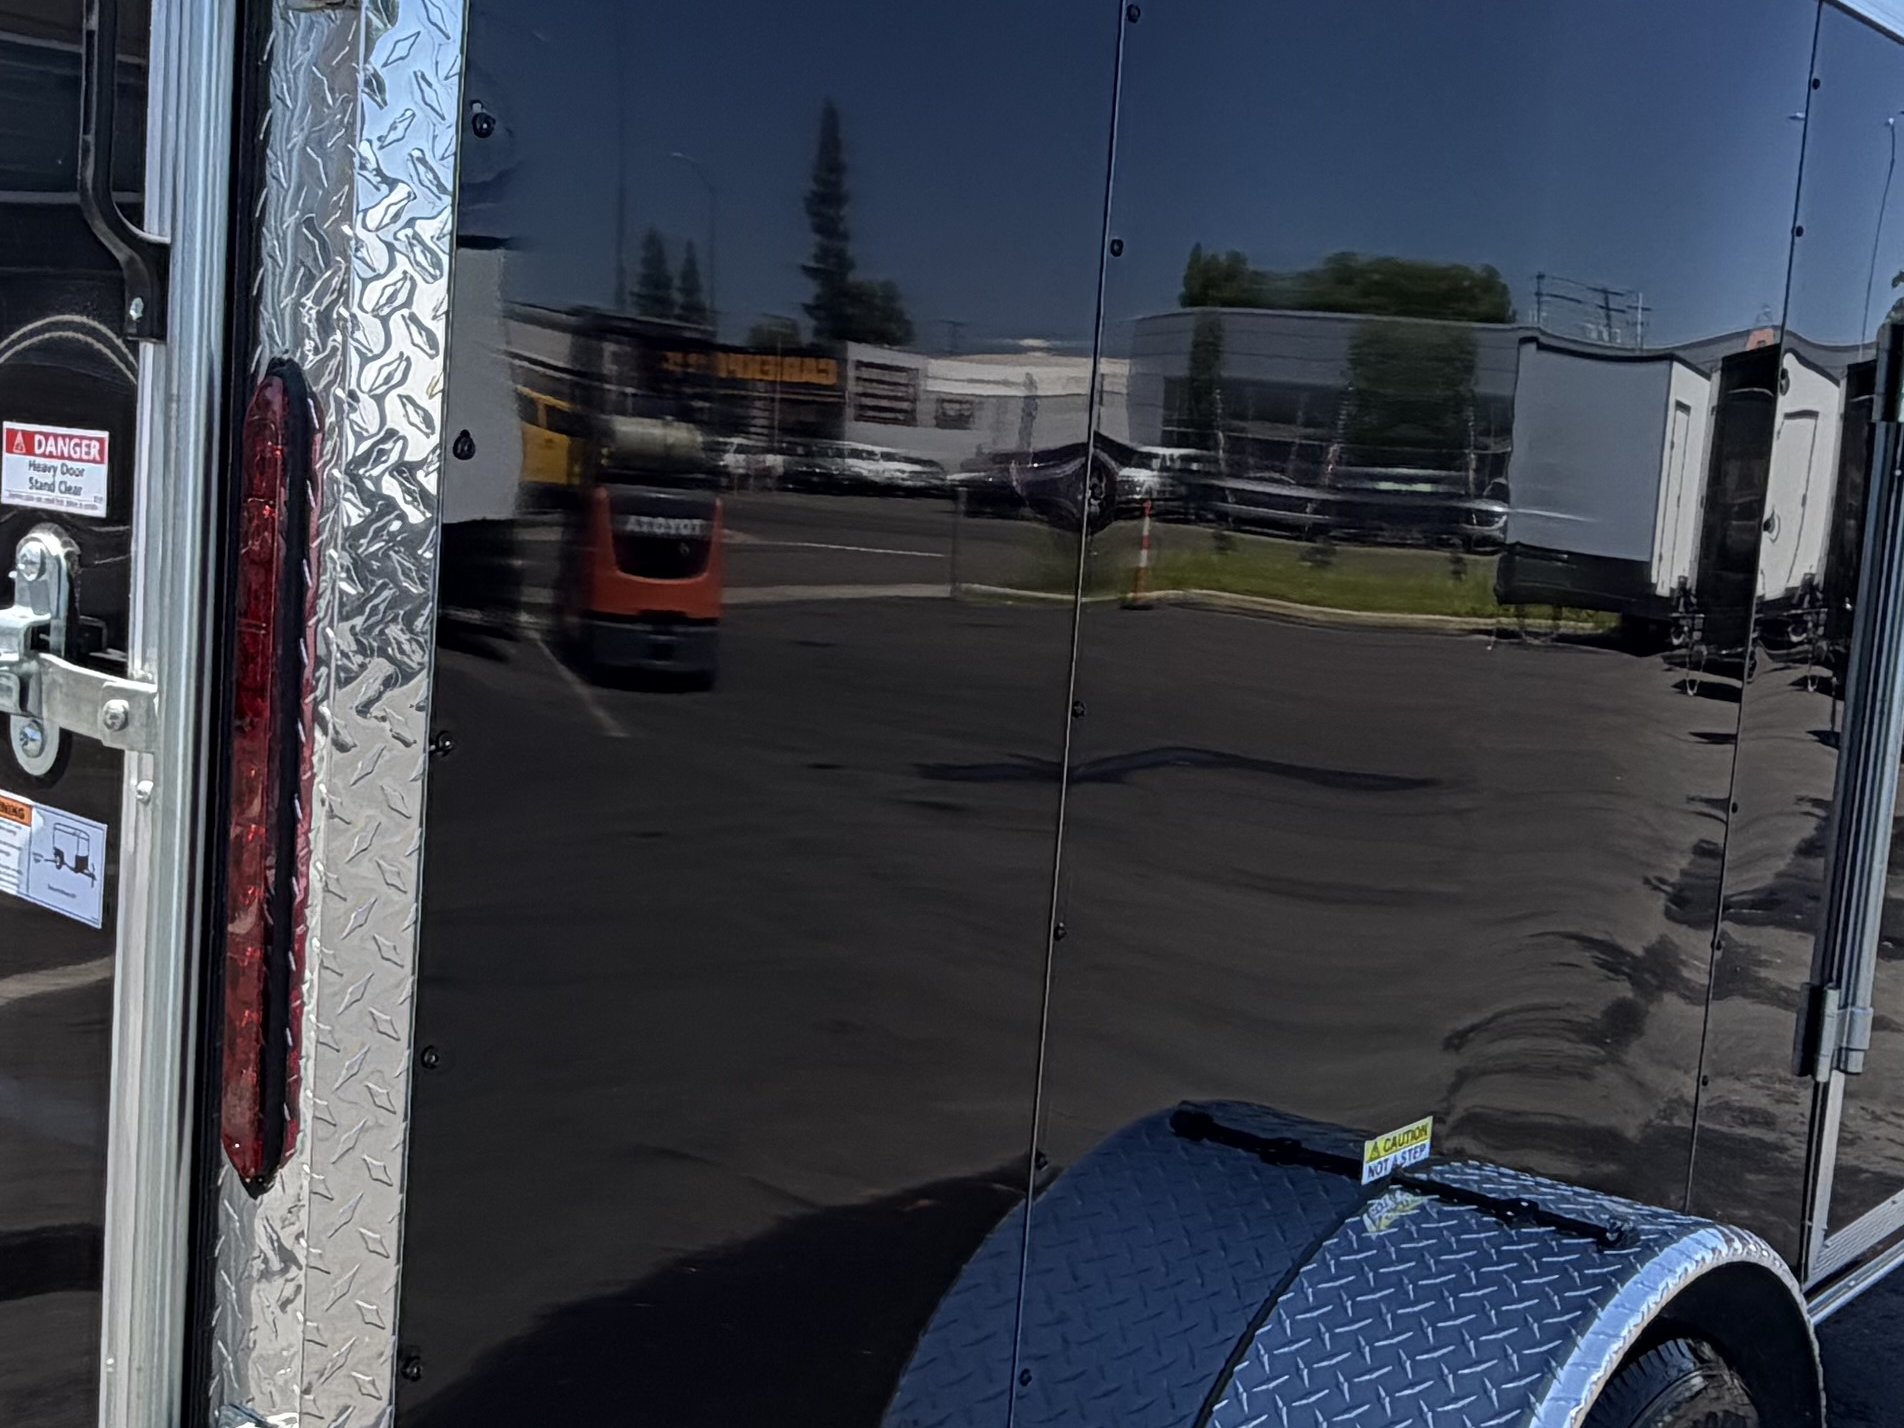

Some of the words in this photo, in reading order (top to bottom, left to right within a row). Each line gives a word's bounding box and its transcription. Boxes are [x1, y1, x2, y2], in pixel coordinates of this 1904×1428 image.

[34, 433, 101, 461] DANGER
[28, 459, 58, 478] Heavy
[60, 462, 85, 478] Door
[28, 476, 56, 493] Stand
[58, 480, 83, 497] Clear
[1383, 1123, 1429, 1153] CAUTION
[1368, 1157, 1389, 1178] NOT
[1400, 1143, 1427, 1167] STEP
